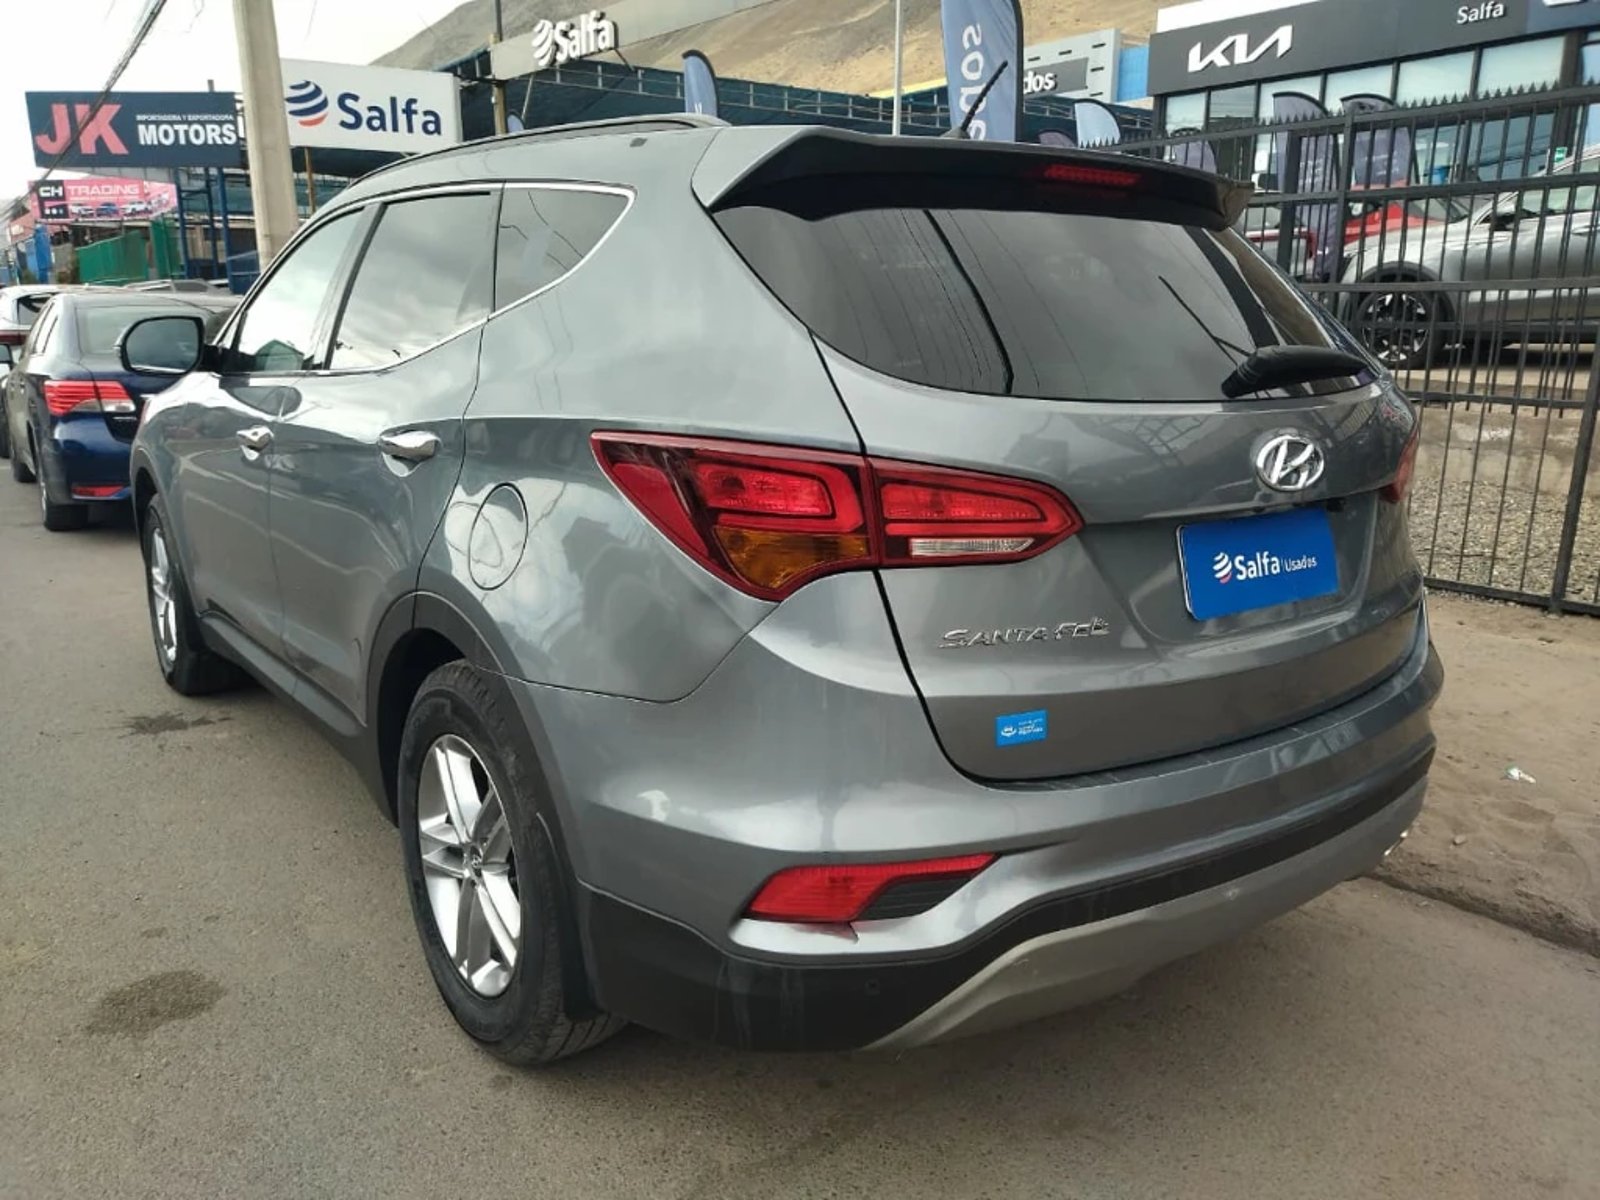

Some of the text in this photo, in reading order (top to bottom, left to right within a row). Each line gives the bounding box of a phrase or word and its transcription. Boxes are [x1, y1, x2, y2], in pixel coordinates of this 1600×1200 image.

[1457, 1, 1505, 24] Salfa
[554, 10, 614, 62] Salfa
[1188, 25, 1293, 72] KIA
[337, 91, 442, 136] Salfa
[35, 104, 129, 155] JK
[138, 123, 237, 145] MOTORS
[67, 184, 139, 195] TRADING
[1234, 551, 1317, 580] Salfa Usados
[939, 627, 1048, 648] SANTA
